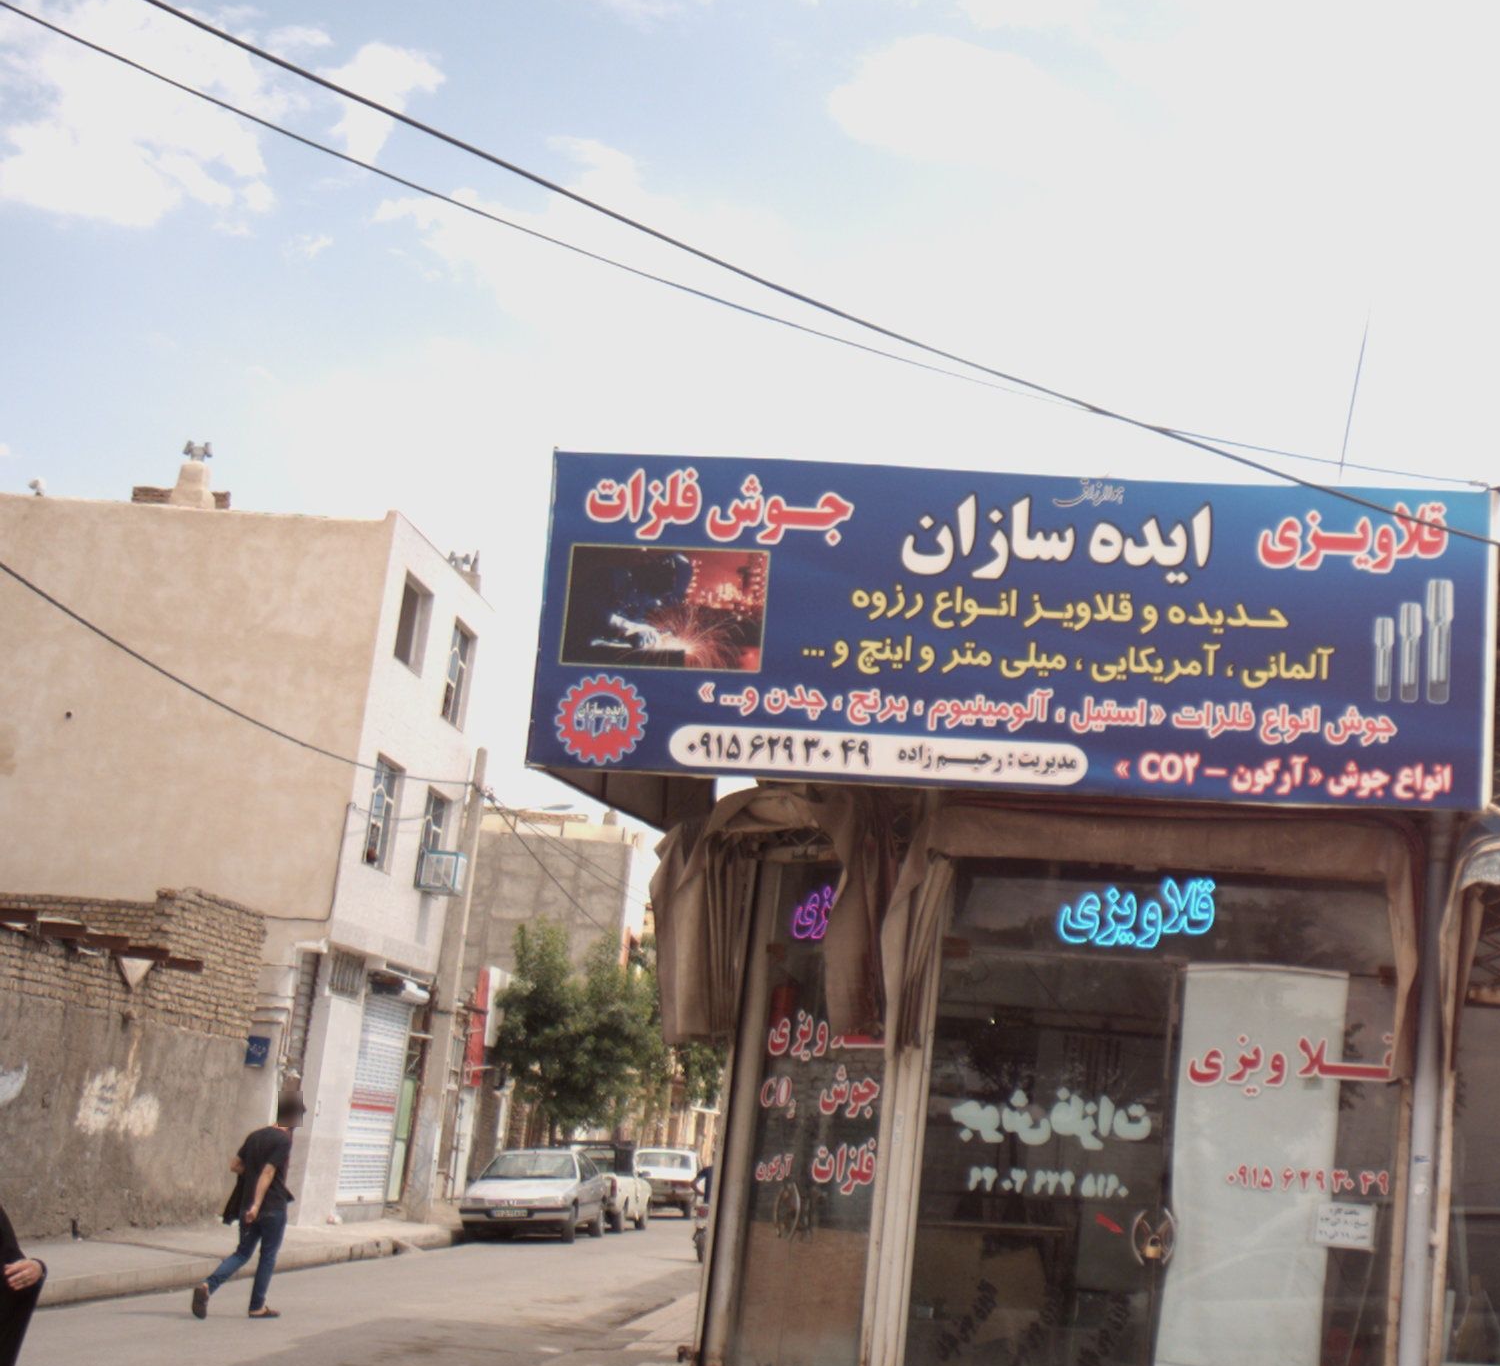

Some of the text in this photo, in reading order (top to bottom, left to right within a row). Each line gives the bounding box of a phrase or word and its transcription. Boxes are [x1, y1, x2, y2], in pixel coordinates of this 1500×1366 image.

[586, 467, 853, 546] جوش فلزات
[901, 494, 1212, 584] ایده سازان
[1258, 500, 1449, 573] قلاویزی
[851, 585, 1290, 635] حدیده و قلاویز انواع رزوه
[856, 635, 912, 675] اینچ
[918, 647, 936, 673] و
[941, 641, 992, 676] متر
[1000, 641, 1067, 677] میلی
[765, 685, 826, 720] چدن
[1174, 701, 1254, 744] فلزات
[1260, 706, 1319, 742] انواع
[1325, 706, 1397, 747] جوش
[1327, 762, 1390, 797] جوش
[1394, 766, 1452, 800] انواع
[1058, 876, 1217, 948] قلاویزی
[818, 1063, 881, 1119] جوش
[810, 1137, 876, 1195] فلزات
